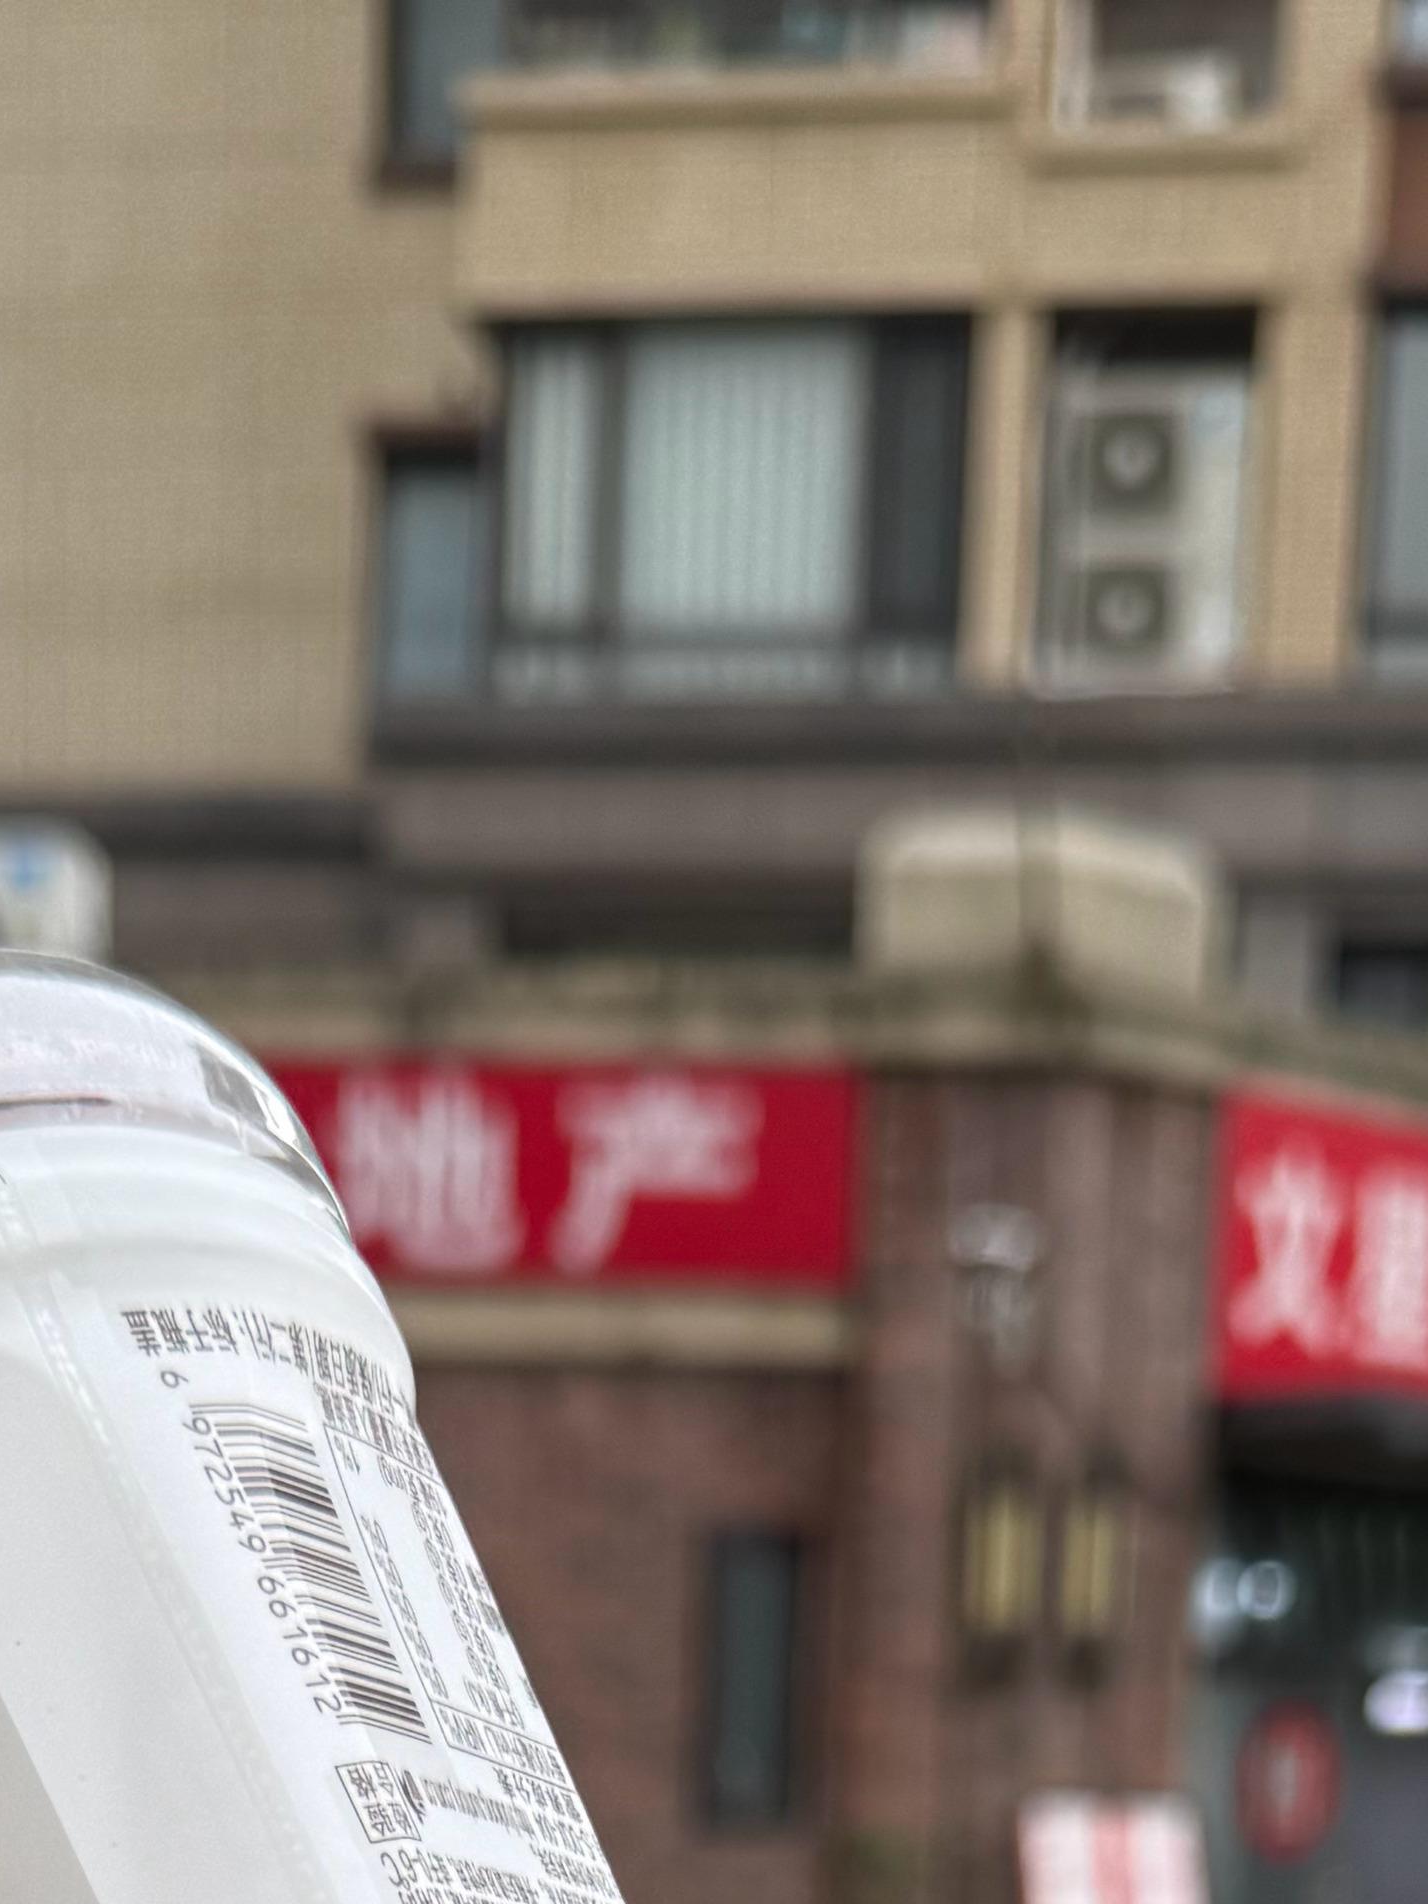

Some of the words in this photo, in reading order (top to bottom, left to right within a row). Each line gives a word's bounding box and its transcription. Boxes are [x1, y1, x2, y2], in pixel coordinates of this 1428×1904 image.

[182, 1415, 269, 1553] 972549
[257, 1574, 343, 1713] 661612
[342, 1763, 400, 1801] 合格
[361, 1801, 416, 1838] 检验
